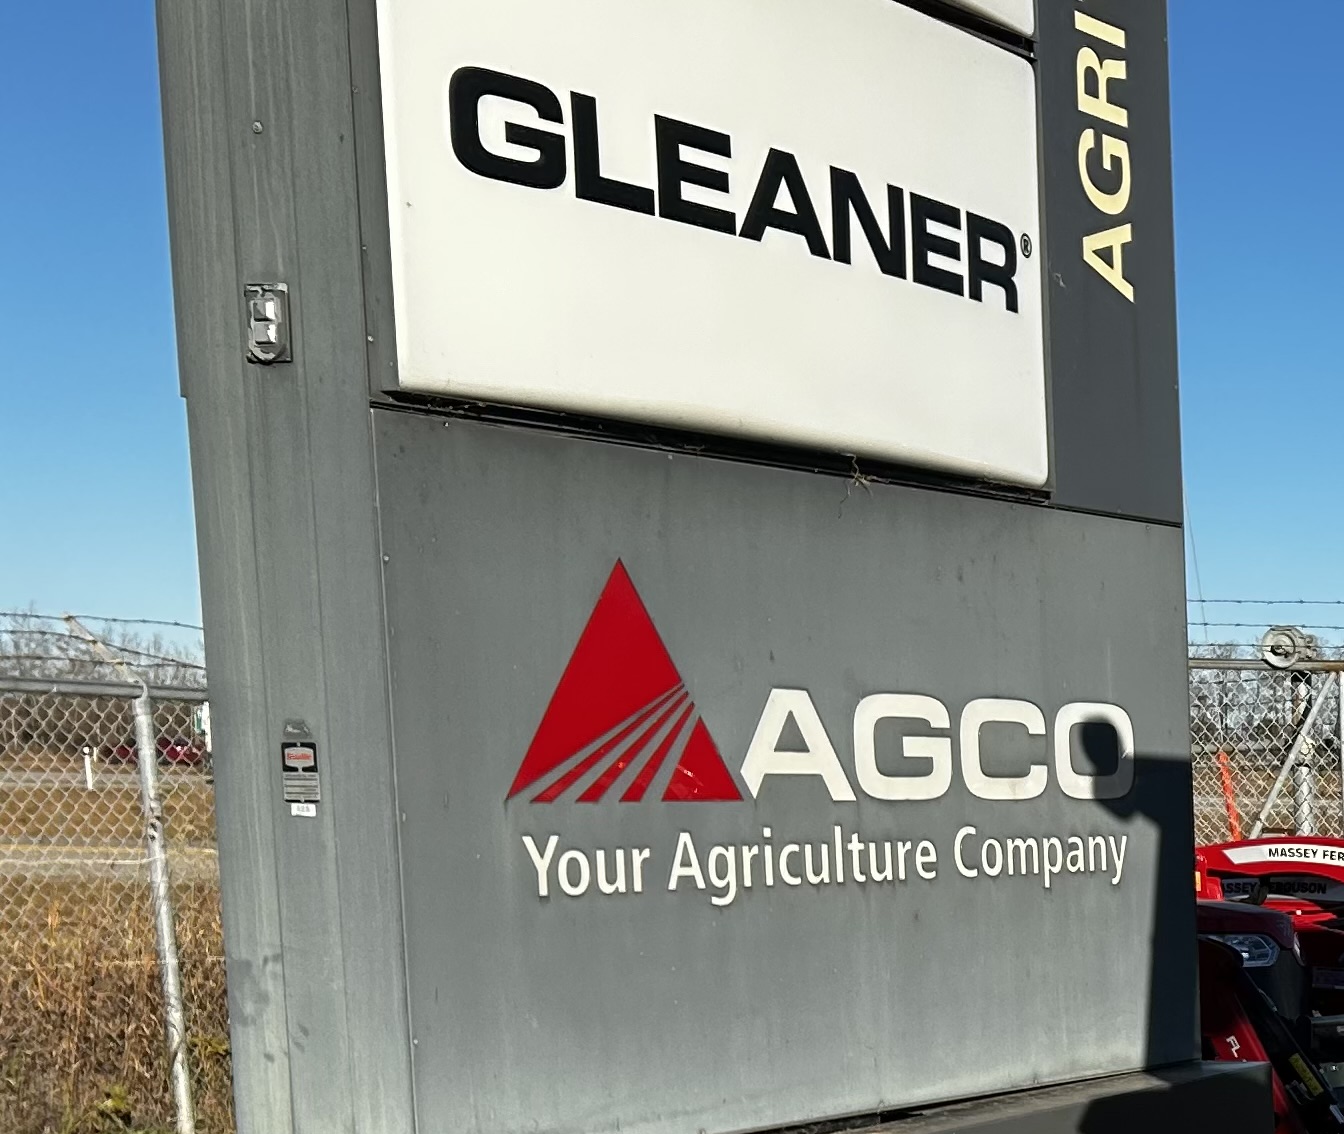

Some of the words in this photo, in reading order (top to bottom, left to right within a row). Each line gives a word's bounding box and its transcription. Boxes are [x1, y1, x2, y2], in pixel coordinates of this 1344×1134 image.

[1074, 0, 1135, 304] AGRI
[740, 688, 1135, 801] AGCO
[522, 834, 650, 898] Your
[668, 826, 939, 906] Agriculture
[953, 826, 1129, 888] Company
[1223, 882, 1258, 894] SSEY
[1268, 847, 1318, 859] MASSEY
